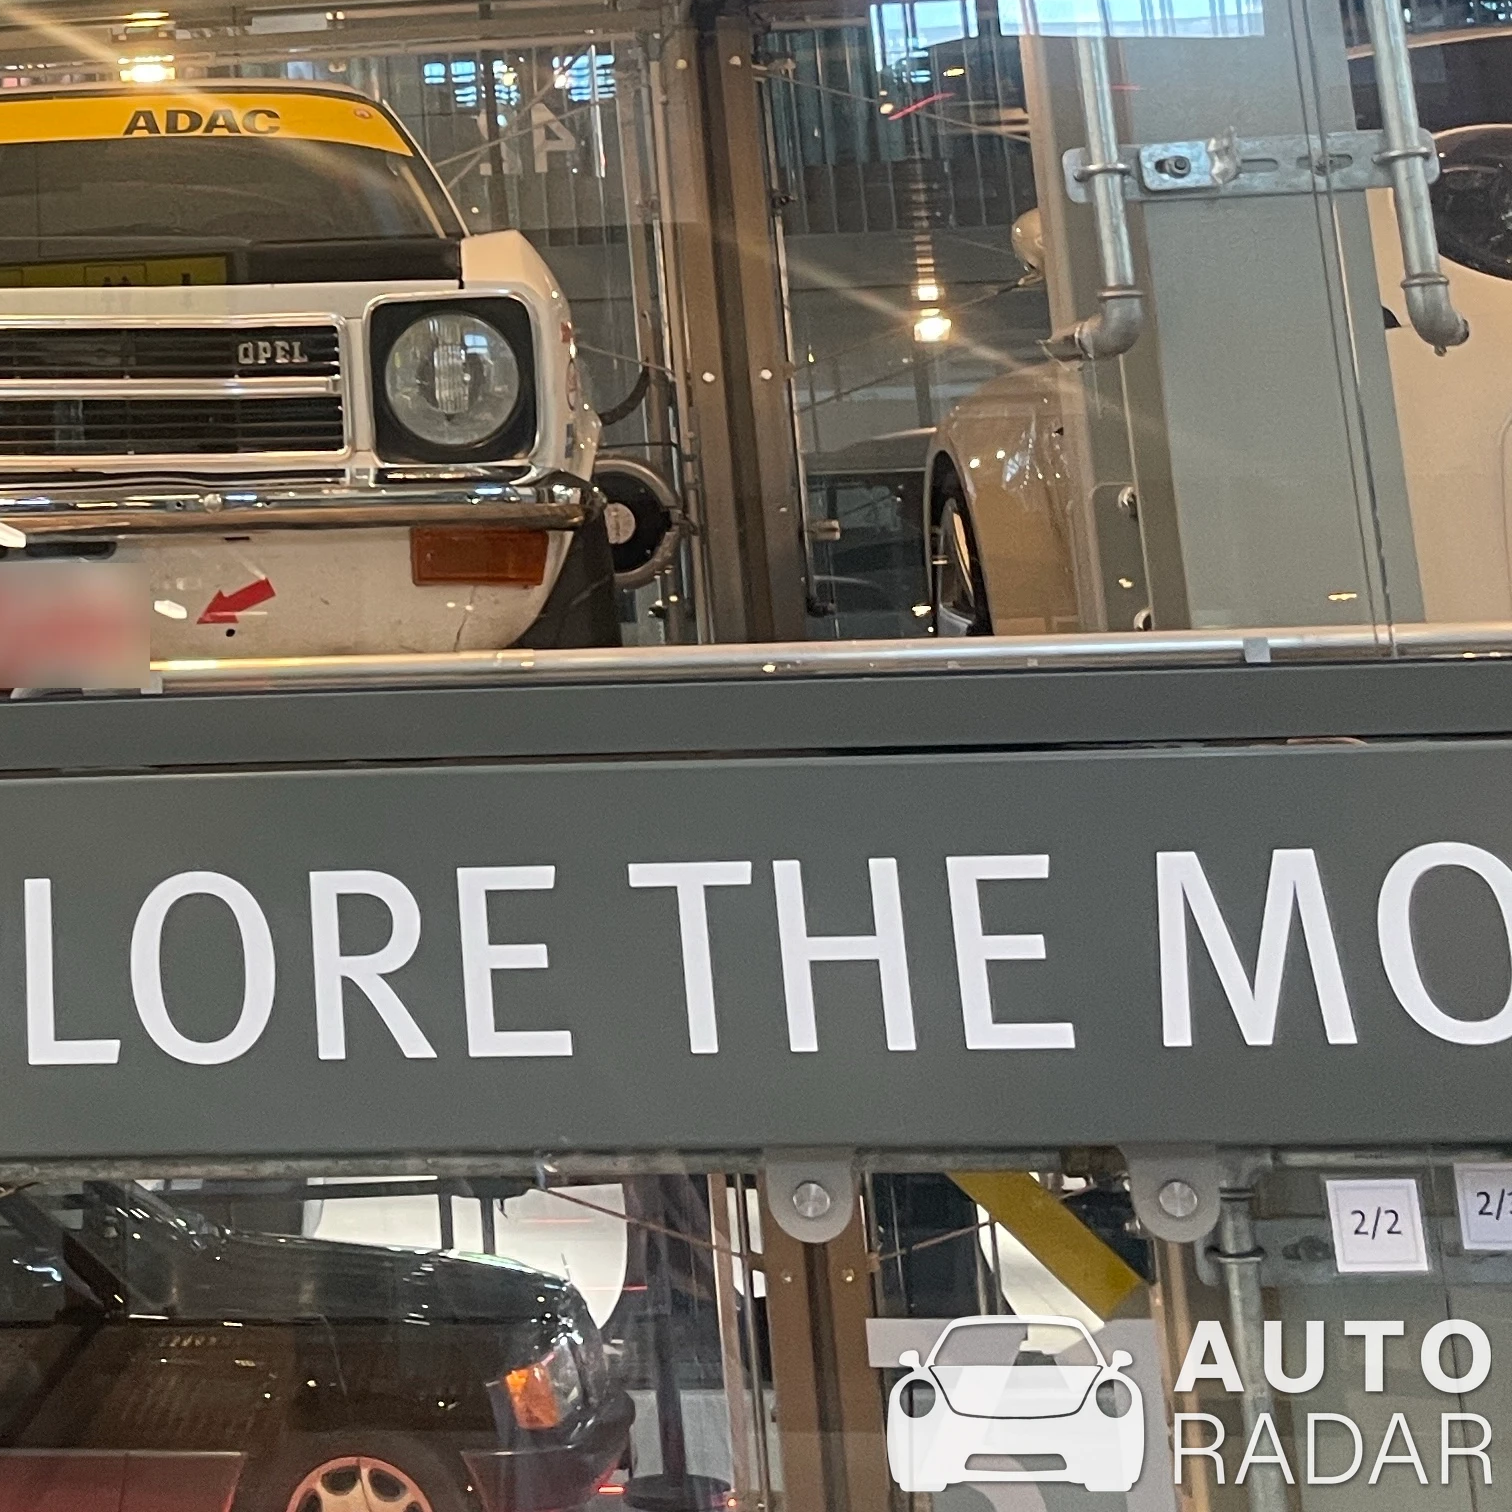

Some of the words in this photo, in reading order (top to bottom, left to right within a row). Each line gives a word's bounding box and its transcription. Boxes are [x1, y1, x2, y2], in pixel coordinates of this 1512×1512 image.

[123, 109, 282, 137] ADAC
[237, 340, 309, 365] OPEL
[628, 854, 1076, 1054] THE
[1156, 841, 1512, 1047] MO
[1351, 1207, 1402, 1240] 2/2
